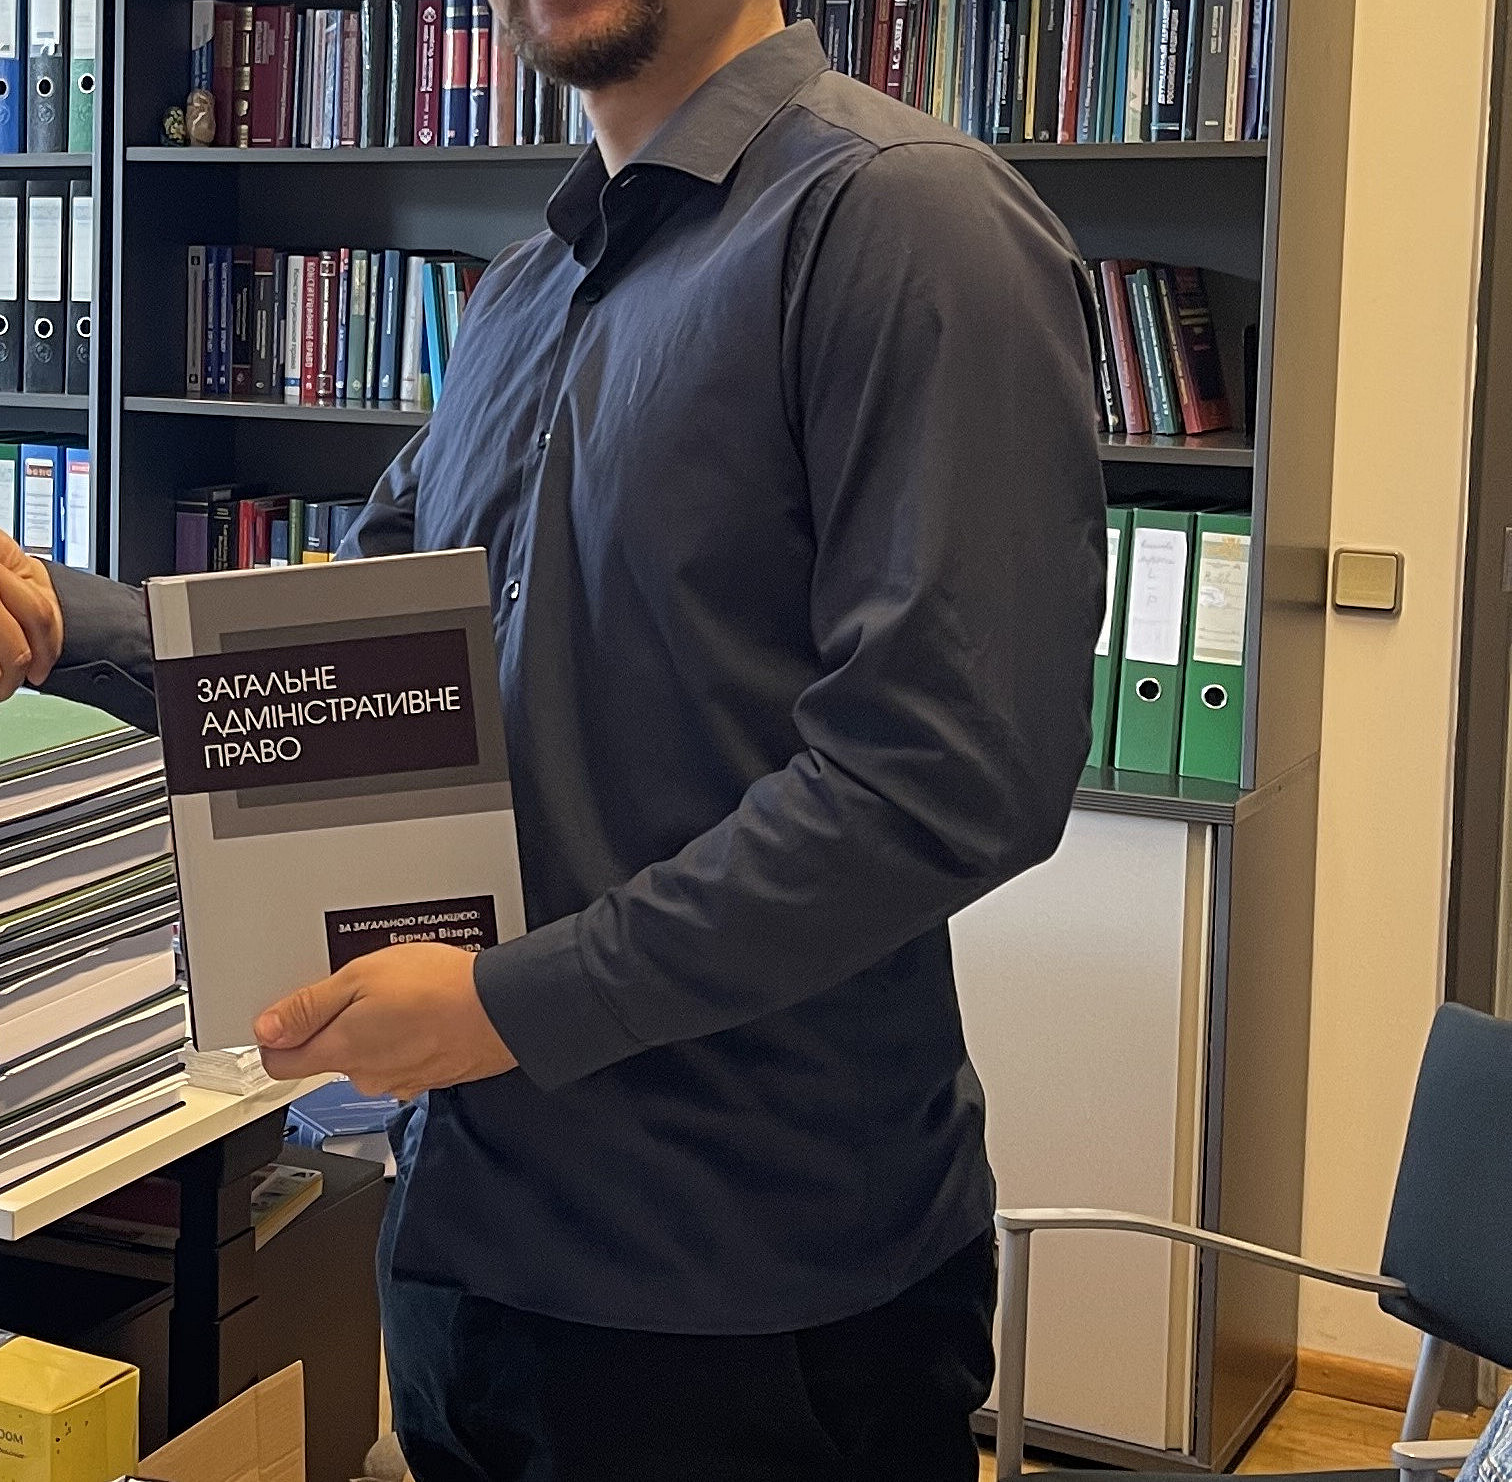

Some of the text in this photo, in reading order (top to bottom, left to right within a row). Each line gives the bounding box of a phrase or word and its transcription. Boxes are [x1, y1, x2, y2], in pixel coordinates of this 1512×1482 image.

[197, 665, 337, 703] ЗАГАЛЬНЕ
[201, 686, 461, 738] АДМІНІСТРАТИВНЕ
[204, 736, 302, 769] ПРАВО
[338, 923, 352, 934] ЗА
